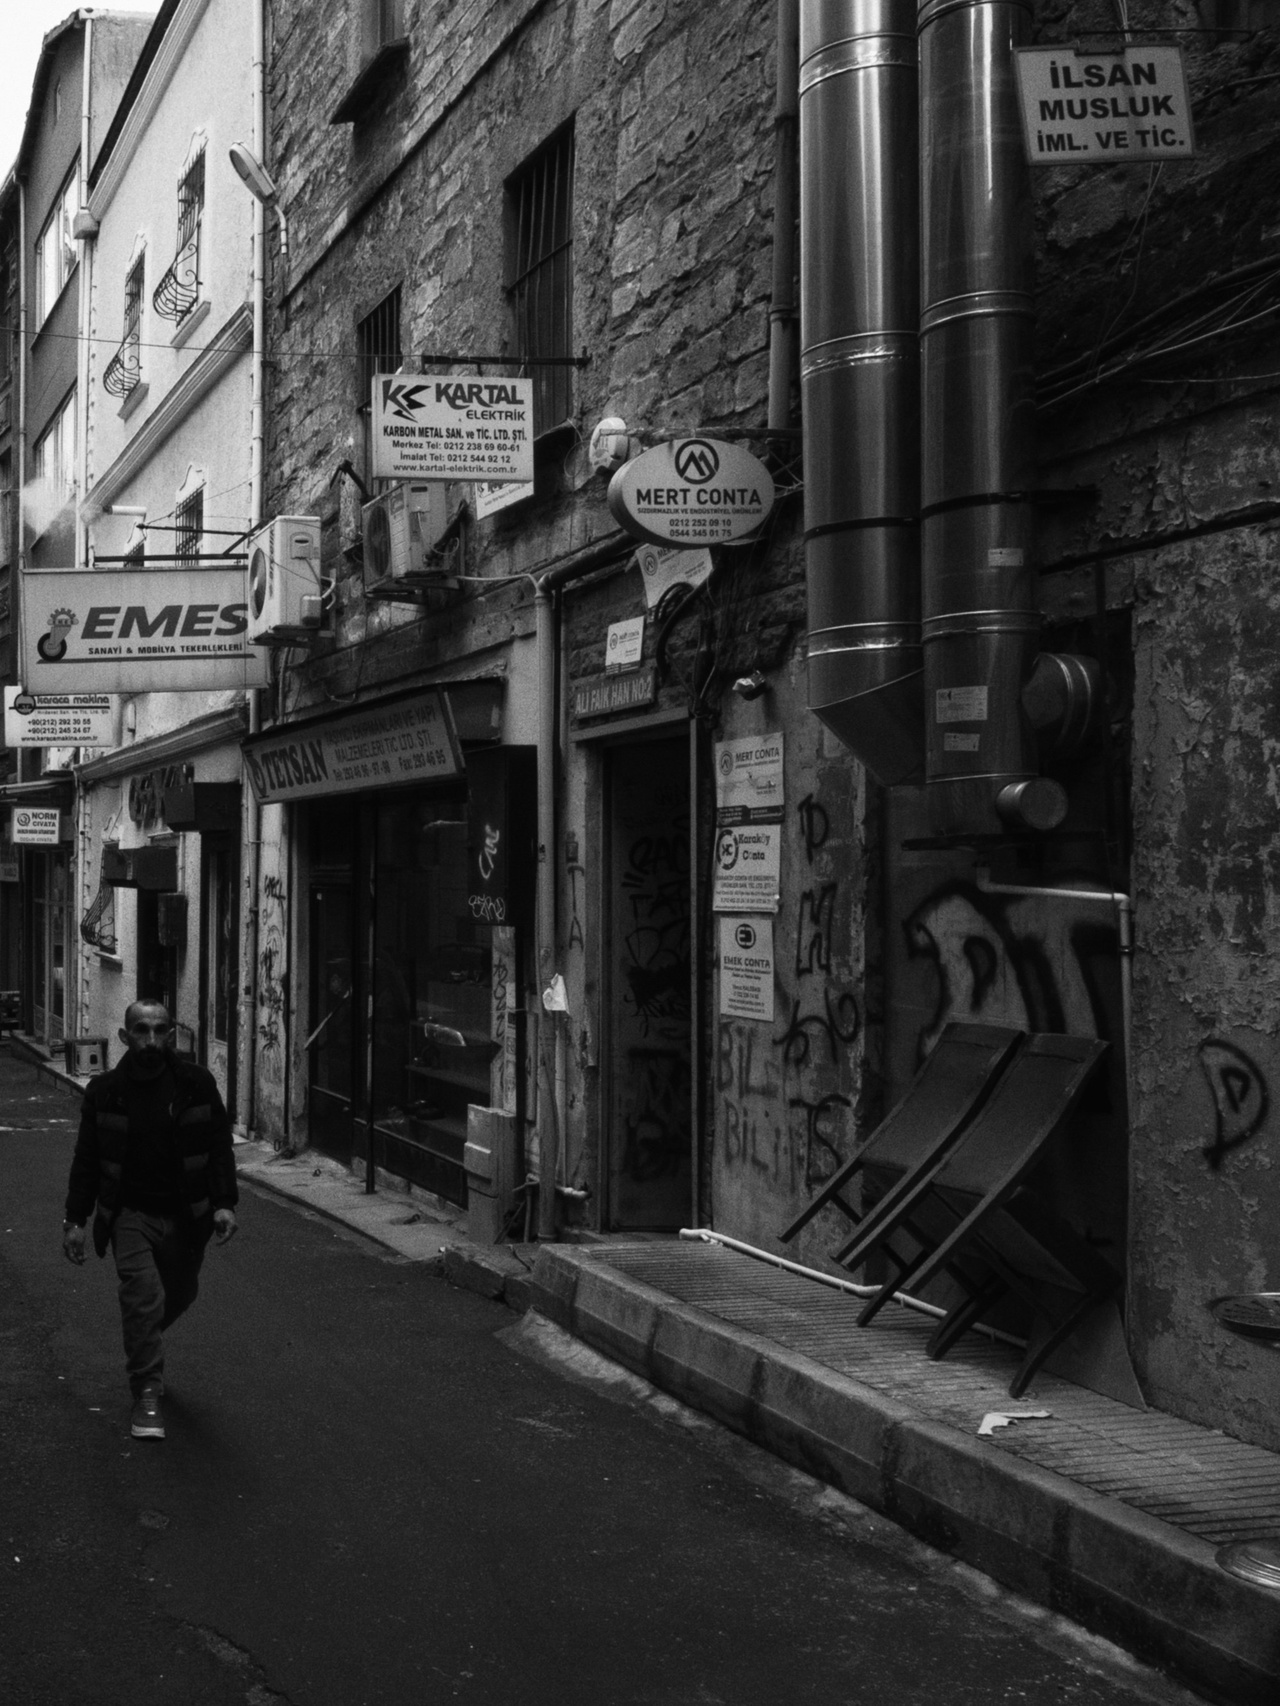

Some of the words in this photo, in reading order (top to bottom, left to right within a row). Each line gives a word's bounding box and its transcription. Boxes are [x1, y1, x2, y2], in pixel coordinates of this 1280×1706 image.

[1050, 61, 1157, 88] İLSAN
[1039, 94, 1176, 121] MUSLUK
[1037, 130, 1089, 152] İML.
[1095, 130, 1129, 150] VE
[1135, 125, 1185, 148] TİC.
[435, 383, 524, 410] KARTAL
[465, 409, 526, 421] ELEKTRİK
[383, 426, 416, 438] KARBON
[418, 427, 444, 439] METAL
[445, 428, 464, 439] SAN.
[465, 430, 475, 439] ve
[476, 426, 492, 440] TİC.
[493, 429, 510, 441] LTD.
[512, 427, 528, 443] ŞTİ.
[392, 440, 423, 449] Merkez
[426, 441, 442, 450] Tel:
[444, 442, 464, 450] 0212
[467, 442, 482, 451] 238
[484, 443, 495, 451] 69
[497, 443, 520, 452] 60-61
[400, 451, 427, 461] İmalat
[429, 453, 445, 461] Tel:
[447, 454, 468, 462] 0212
[470, 455, 485, 463] 544
[488, 455, 498, 463] 92
[393, 464, 517, 474] www.kartal-elektrik.com.tr
[636, 488, 691, 505] MERT
[696, 488, 762, 505] CONTA
[669, 529, 690, 537] 0544
[692, 529, 707, 537] 345
[709, 529, 719, 537] 01
[722, 529, 732, 537] 75
[81, 603, 249, 639] EMES
[88, 645, 123, 655] SANAYİ
[126, 646, 133, 654] &
[138, 644, 176, 655] MOBİLYA
[36, 695, 70, 704] karaca
[73, 694, 110, 704] makina
[28, 718, 57, 726] +90(212)
[28, 727, 57, 735] +90(212)
[735, 751, 753, 762] MERT
[754, 747, 780, 760] CONTA
[31, 812, 57, 820] NORM
[723, 956, 742, 966] EMEK
[744, 958, 770, 969] CONTA
